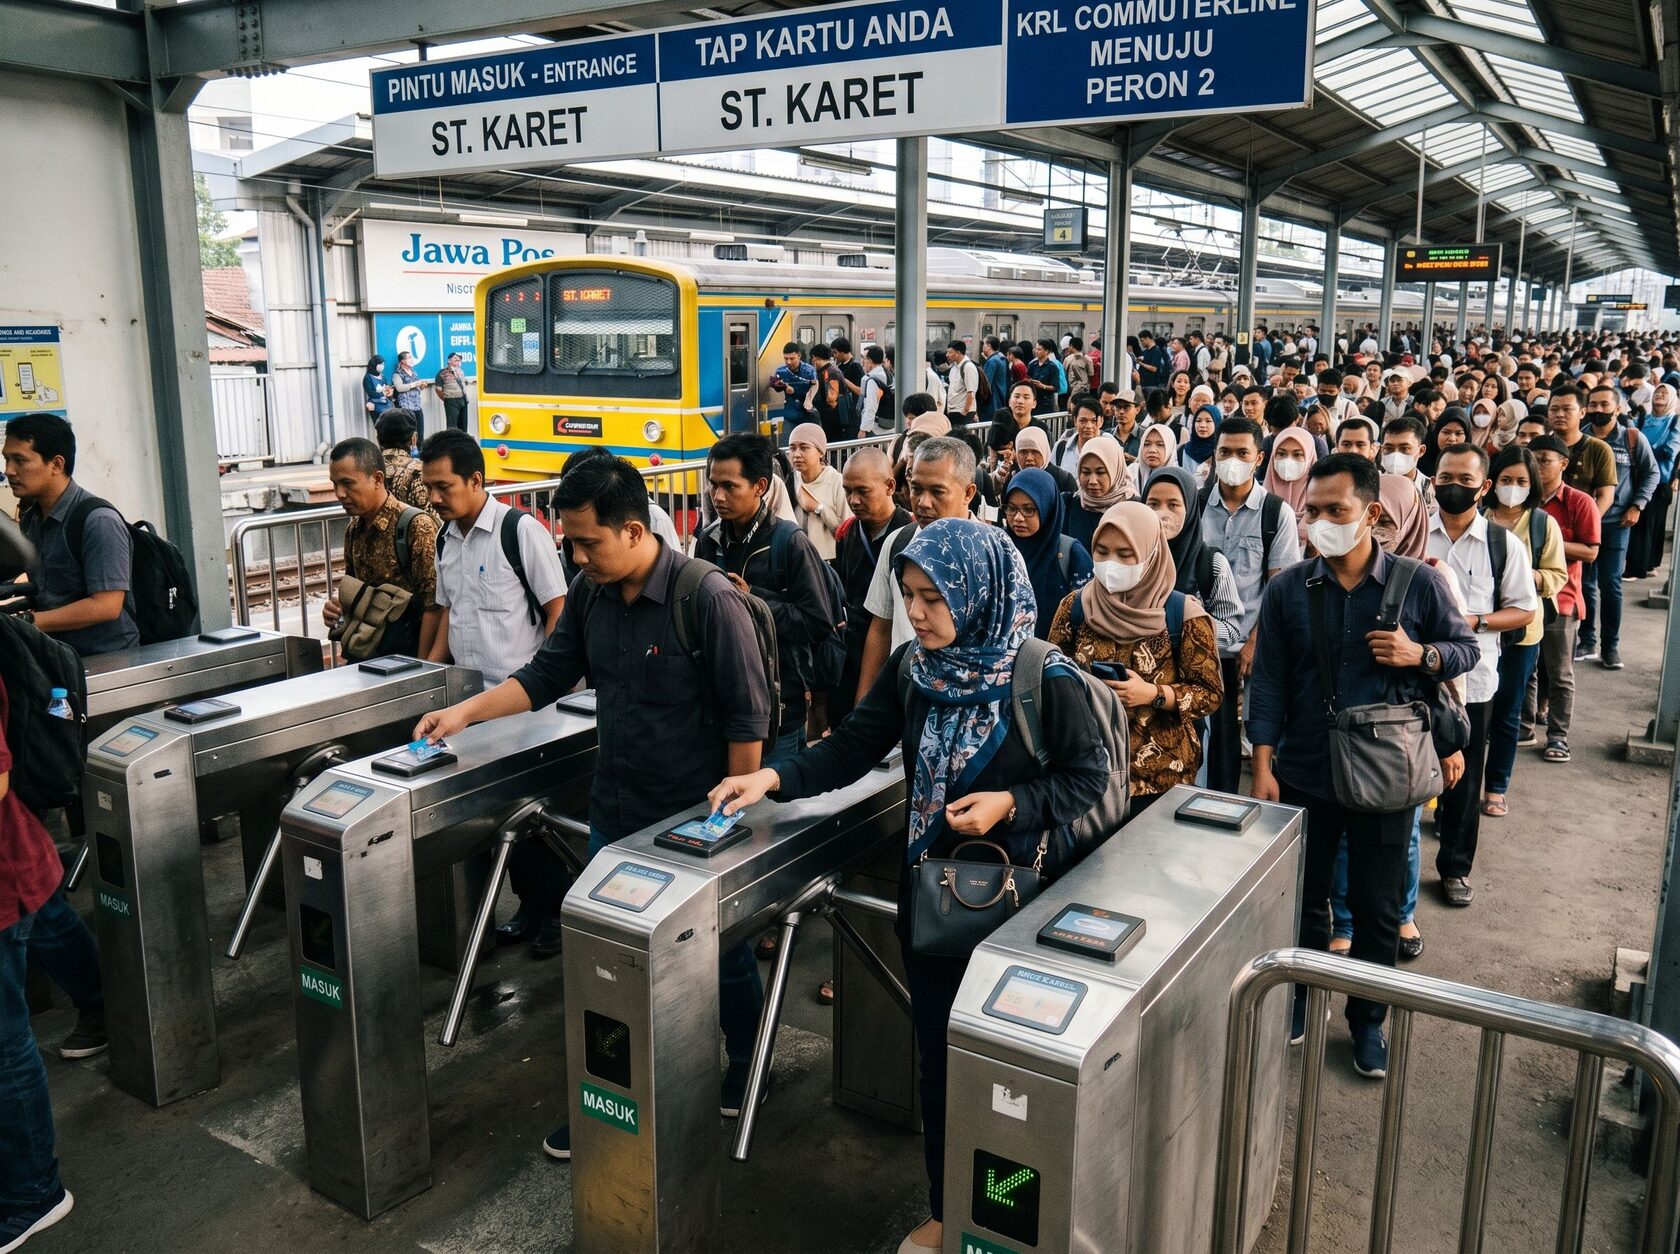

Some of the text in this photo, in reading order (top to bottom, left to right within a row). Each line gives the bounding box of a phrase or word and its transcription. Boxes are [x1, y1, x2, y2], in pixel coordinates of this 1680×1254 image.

[695, 7, 954, 66] TAP KARTU ANDA
[1017, 9, 1068, 37] KRL
[1090, 28, 1213, 67] MENUJU
[388, 73, 445, 103] PINTU
[450, 61, 526, 95] MASUK
[543, 53, 637, 84] ENTRANCE
[1086, 68, 1215, 104] PERON 2
[720, 70, 924, 131] ST. KARET
[431, 105, 588, 157] ST. KARET
[401, 233, 490, 266] Jawa
[1059, 229, 1067, 240] 4
[100, 892, 130, 916] MASUK
[301, 972, 341, 1001] MASUK
[583, 1090, 636, 1126] MASUK
